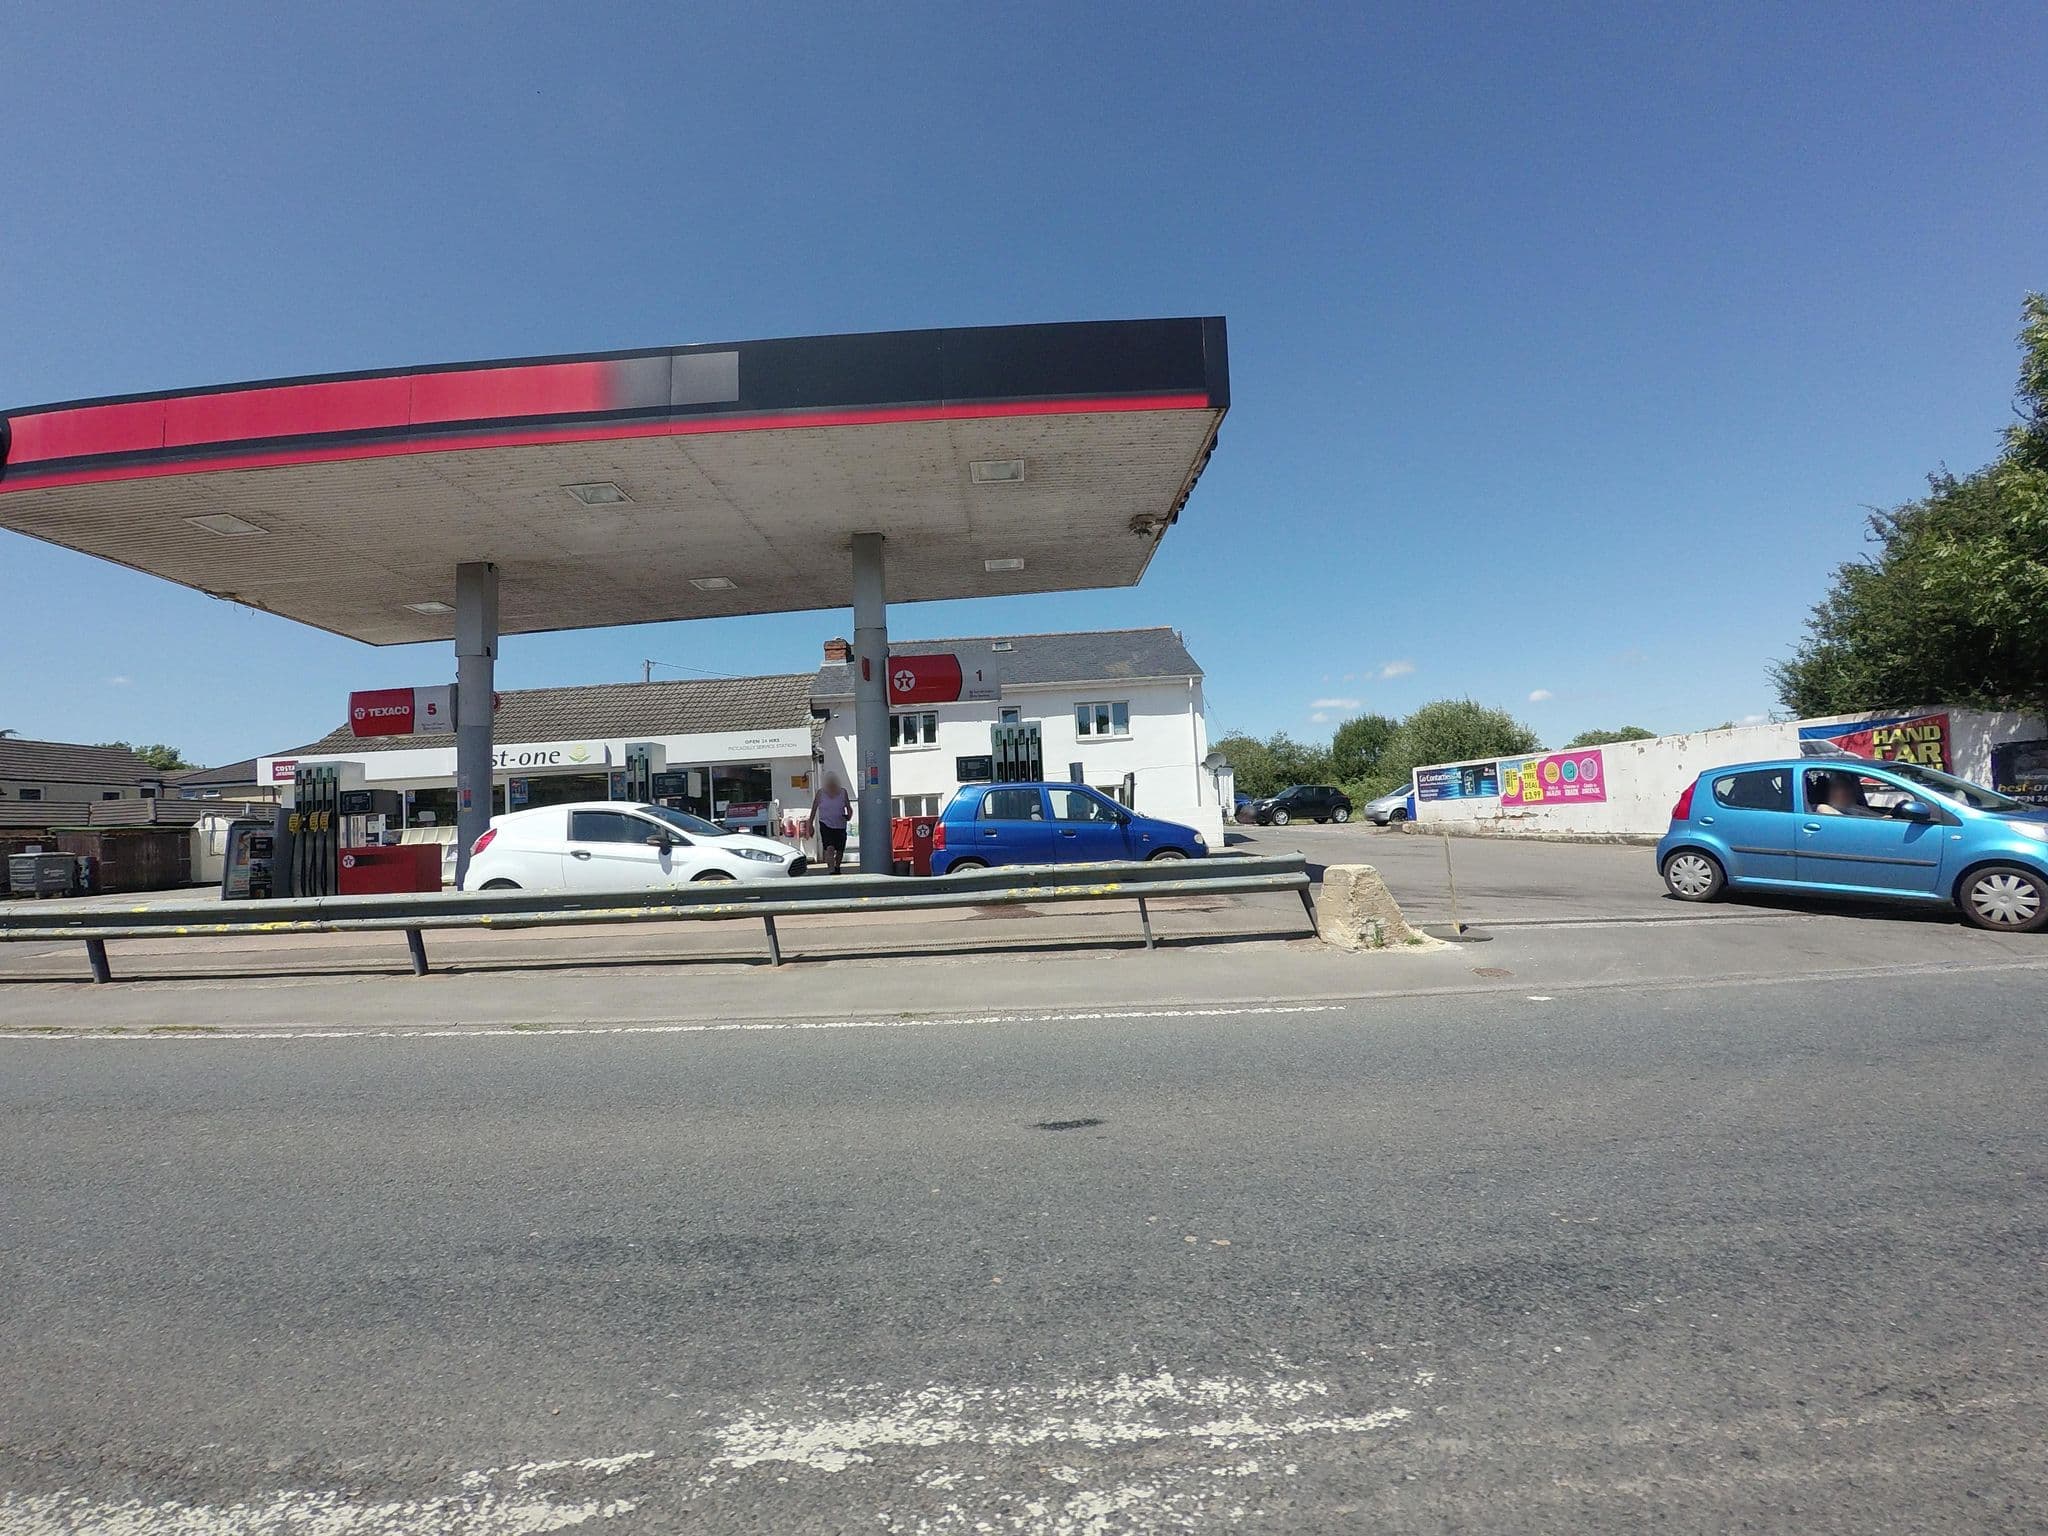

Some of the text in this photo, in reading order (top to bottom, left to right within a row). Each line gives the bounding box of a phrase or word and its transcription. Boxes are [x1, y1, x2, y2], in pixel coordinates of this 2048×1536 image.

[976, 669, 983, 682] 1
[368, 706, 410, 717] TEXACO
[427, 703, 437, 716] 5
[1873, 726, 1941, 745] HAND
[1525, 791, 1541, 800] £3.99
